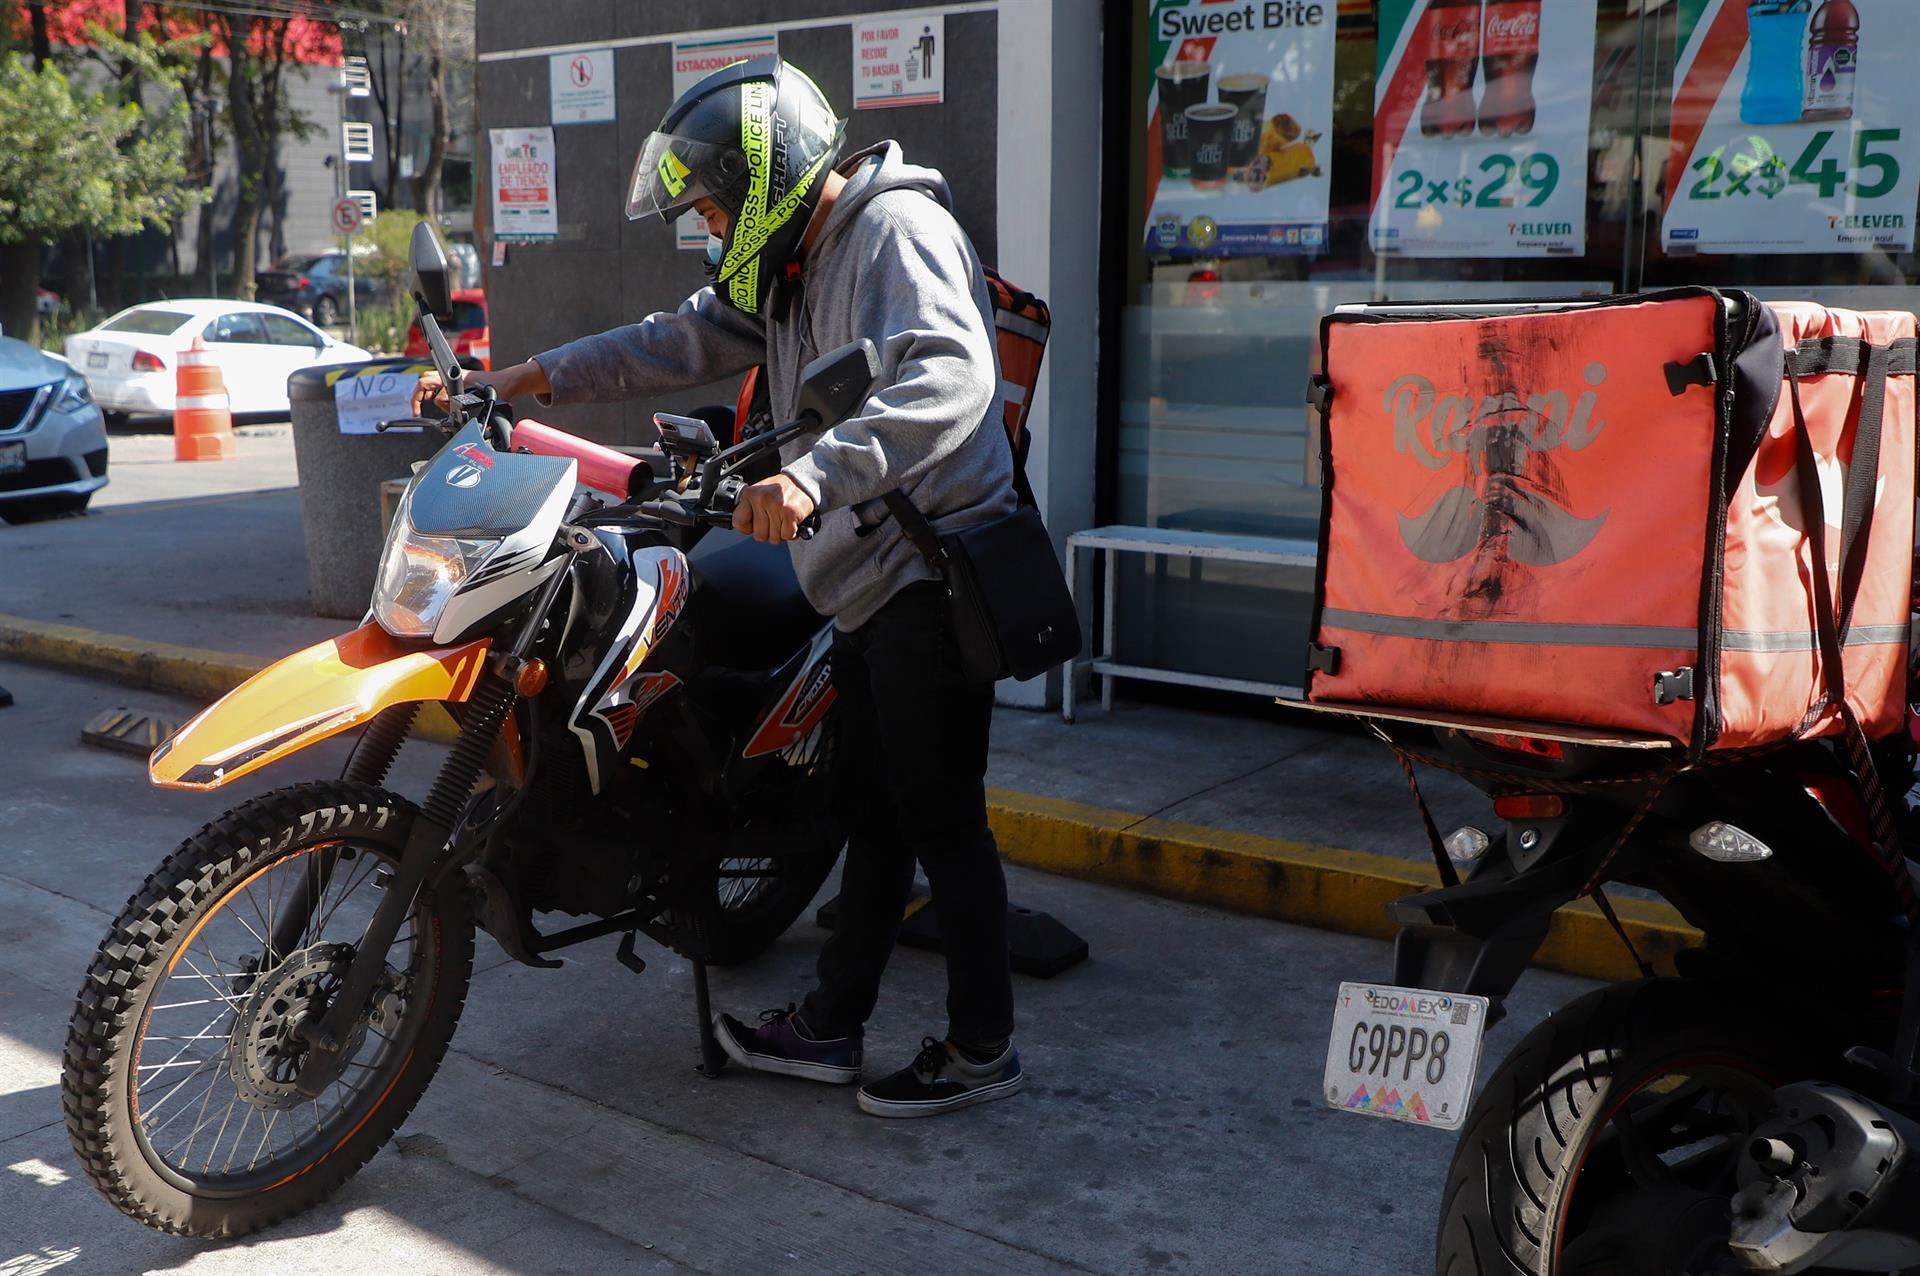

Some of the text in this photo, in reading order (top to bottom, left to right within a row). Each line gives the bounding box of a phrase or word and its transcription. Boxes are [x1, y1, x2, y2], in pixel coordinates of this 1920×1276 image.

[1162, 0, 1323, 37] Sweet Bite
[877, 27, 899, 40] FAVOR
[872, 63, 900, 77] BASURA
[499, 162, 549, 175] EMPLEADO
[515, 175, 548, 187] TIENDA
[353, 375, 396, 400] NO
[1382, 361, 1607, 476] Rappi
[1348, 1021, 1450, 1085] G9PP8
